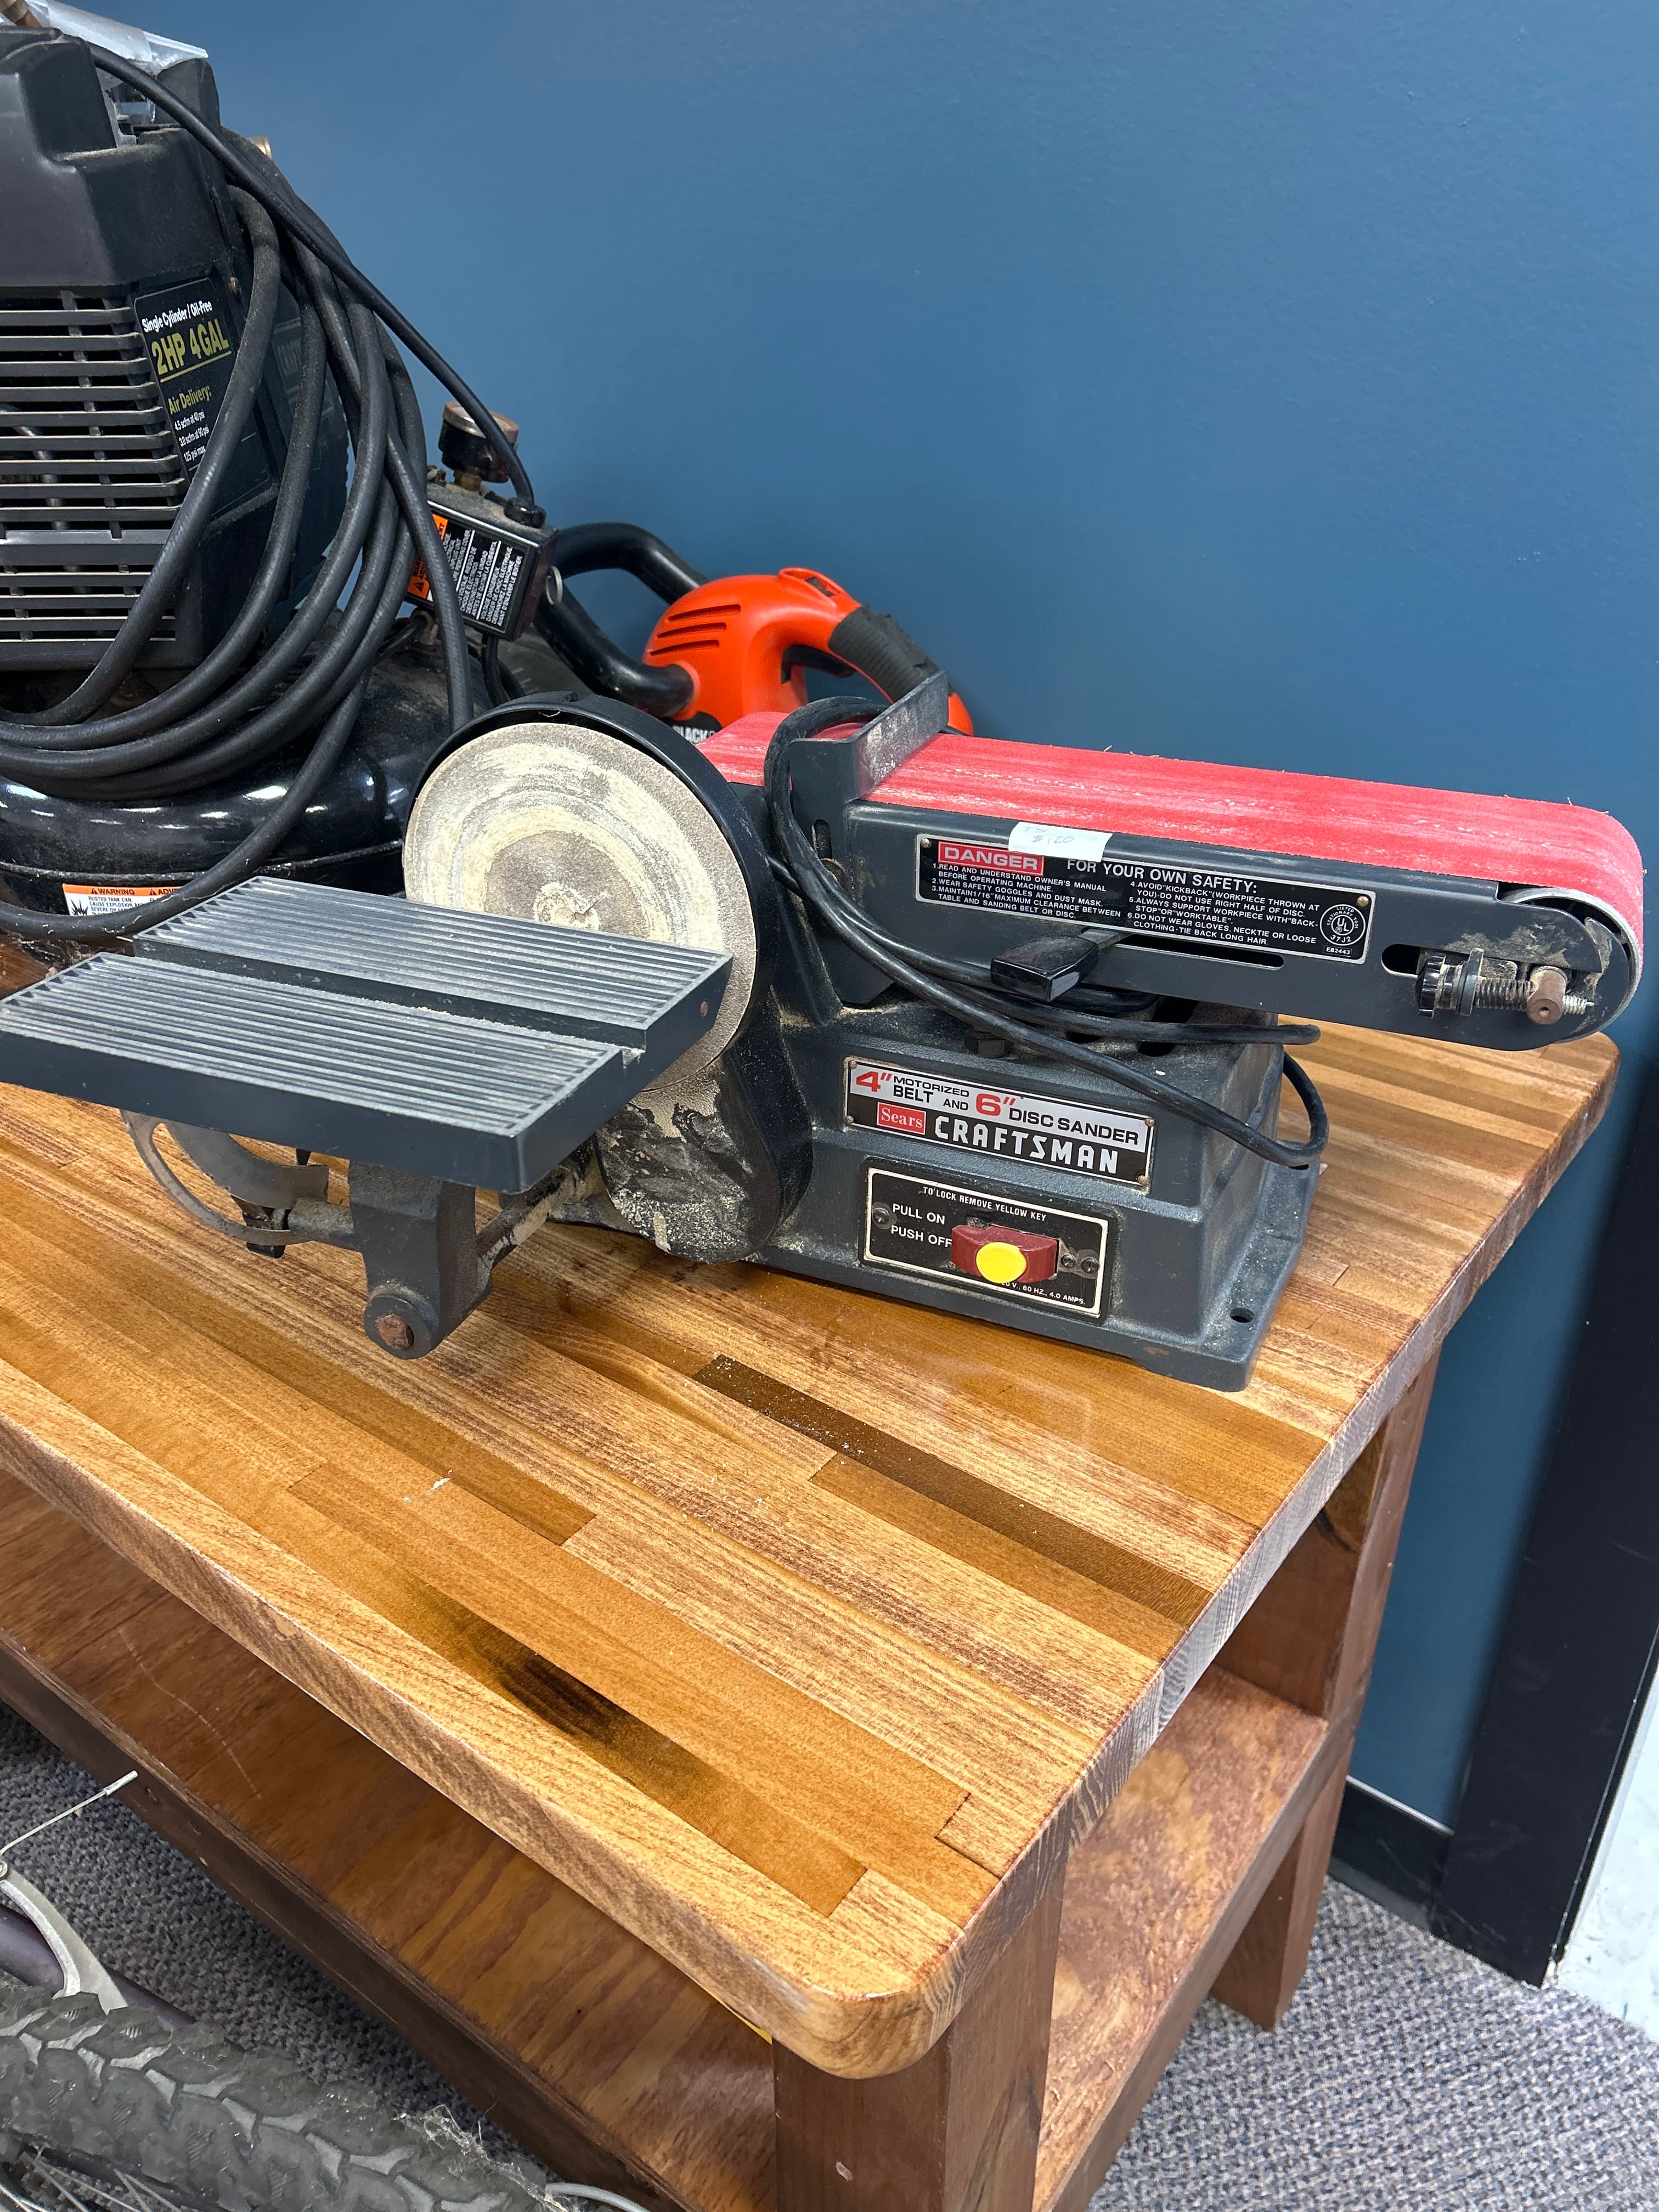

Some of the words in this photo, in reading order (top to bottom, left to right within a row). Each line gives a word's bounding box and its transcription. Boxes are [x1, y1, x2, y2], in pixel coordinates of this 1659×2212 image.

[142, 315, 163, 332] Single
[162, 308, 188, 328] Cylinder
[190, 300, 212, 317] Oil-Free
[151, 332, 185, 375] 2HP
[189, 318, 229, 359] 4GAL
[168, 396, 180, 415] Air
[179, 385, 212, 409] Delivery:
[190, 414, 195, 424] at
[194, 411, 199, 422] 40
[194, 430, 199, 439] at
[198, 427, 204, 437] 90
[945, 847, 1037, 870] DANGER
[1067, 860, 1096, 873] FOR
[1103, 863, 1144, 879] YOUR
[1150, 868, 1186, 884] OWN
[1192, 874, 1257, 894] SAFETY:
[980, 870, 1031, 881] UNDERSTAND
[1035, 877, 1070, 887] OWNER'S
[1074, 882, 1107, 892] MANUAL
[939, 872, 967, 880] BEFORE
[970, 876, 1013, 887] OPERATING
[1017, 882, 1053, 892] MACHINE.
[963, 882, 992, 891] SAFETY
[995, 887, 1032, 897] GOGGLES
[1078, 899, 1103, 907] MASK.
[1268, 898, 1306, 909] THROWN
[938, 894, 961, 902] TABLE
[983, 900, 1017, 910] SANDING
[1056, 910, 1076, 919] DISC.
[1034, 900, 1080, 911] CLEARANCE
[1082, 906, 1121, 917] BETWEEN
[1172, 902, 1211, 913] SUPPORT
[1214, 907, 1263, 920] WORKPIECE
[1215, 900, 1241, 909] RIGHT
[1244, 904, 1266, 912] HALF
[1283, 909, 1305, 918] DISC.
[1327, 911, 1353, 926] STATIONARY
[1169, 917, 1193, 926] WEAR
[1234, 927, 1269, 937] NECKTIE
[1287, 934, 1317, 944] LOOSE
[1194, 929, 1217, 938] BACK
[1220, 933, 1244, 941] LONG
[1247, 936, 1269, 945] HAIR.
[1330, 934, 1351, 943] 37J2
[856, 1071, 892, 1092] 4"
[893, 1076, 969, 1097] MOTORIZED
[893, 1087, 934, 1103] BELT
[943, 1098, 969, 1111] AND
[975, 1093, 1017, 1116] 6"
[1008, 1108, 1054, 1127] DISC
[1057, 1119, 1139, 1144] SANDER
[881, 1104, 923, 1128] Sears
[935, 1115, 1119, 1173] CRAFTSMAN
[893, 1204, 922, 1219] PULL
[927, 1212, 945, 1225] ON
[936, 1189, 956, 1201] LOCK
[959, 1195, 992, 1209] REMOVE
[995, 1203, 1027, 1217] YELLOW
[1030, 1212, 1047, 1222] KEY
[891, 1226, 923, 1242] PUSH
[929, 1234, 952, 1248] OFF
[1063, 1294, 1086, 1305] AMPS.
